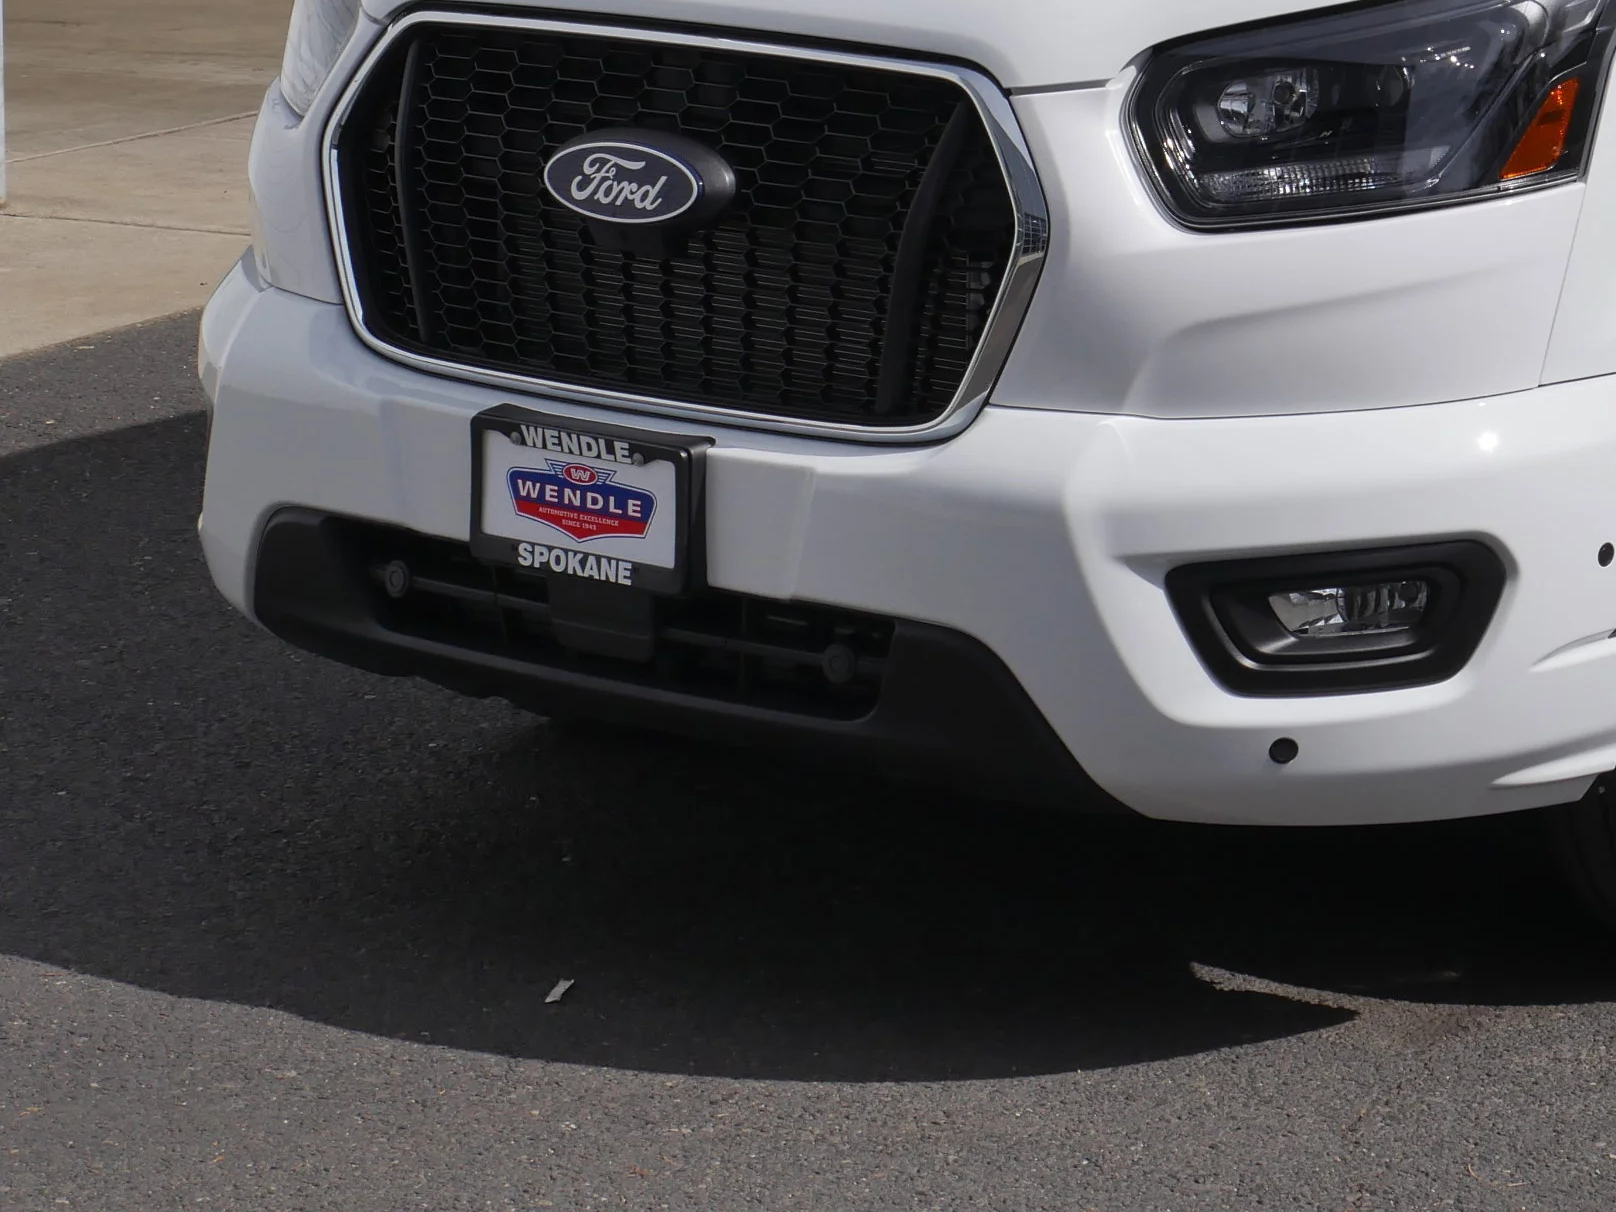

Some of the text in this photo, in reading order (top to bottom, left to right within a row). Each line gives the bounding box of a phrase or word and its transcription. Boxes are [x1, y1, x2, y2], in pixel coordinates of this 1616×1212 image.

[570, 152, 668, 211] Ford
[520, 424, 633, 465] WENDLE
[517, 478, 643, 518] WENDLE
[538, 506, 619, 527] AUTOMOTIVE EXCELLENCE
[561, 518, 581, 528] SINCE
[517, 542, 633, 586] SPOKANE
